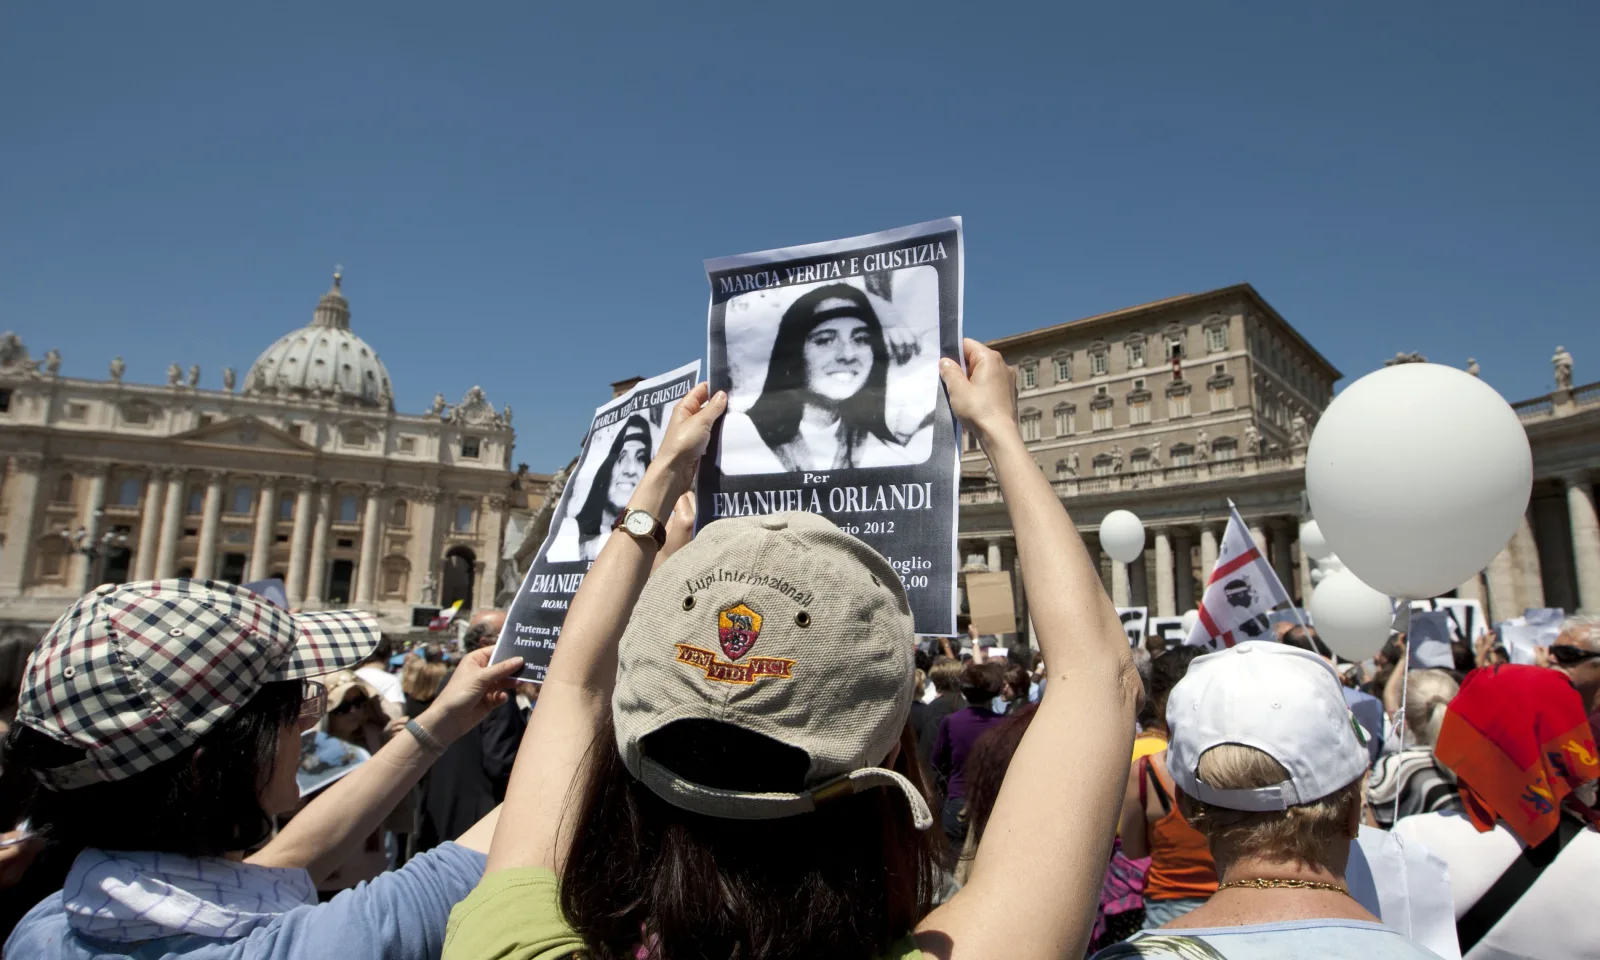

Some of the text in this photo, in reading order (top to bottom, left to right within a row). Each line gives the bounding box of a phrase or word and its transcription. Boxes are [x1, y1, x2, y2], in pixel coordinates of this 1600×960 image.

[719, 241, 948, 294] MARCIA VERITA' E GIUSTIZIA
[642, 393, 650, 408] E
[650, 379, 691, 406] GIUSTIZIA
[803, 473, 830, 484] Per
[712, 482, 933, 517] EMANUELA ORLANDI
[864, 521, 895, 534] 2012
[541, 599, 568, 610] ROMA
[515, 622, 550, 635] Partenza
[514, 636, 541, 648] Arrivo
[682, 648, 785, 681] VENI VIDI VICI
